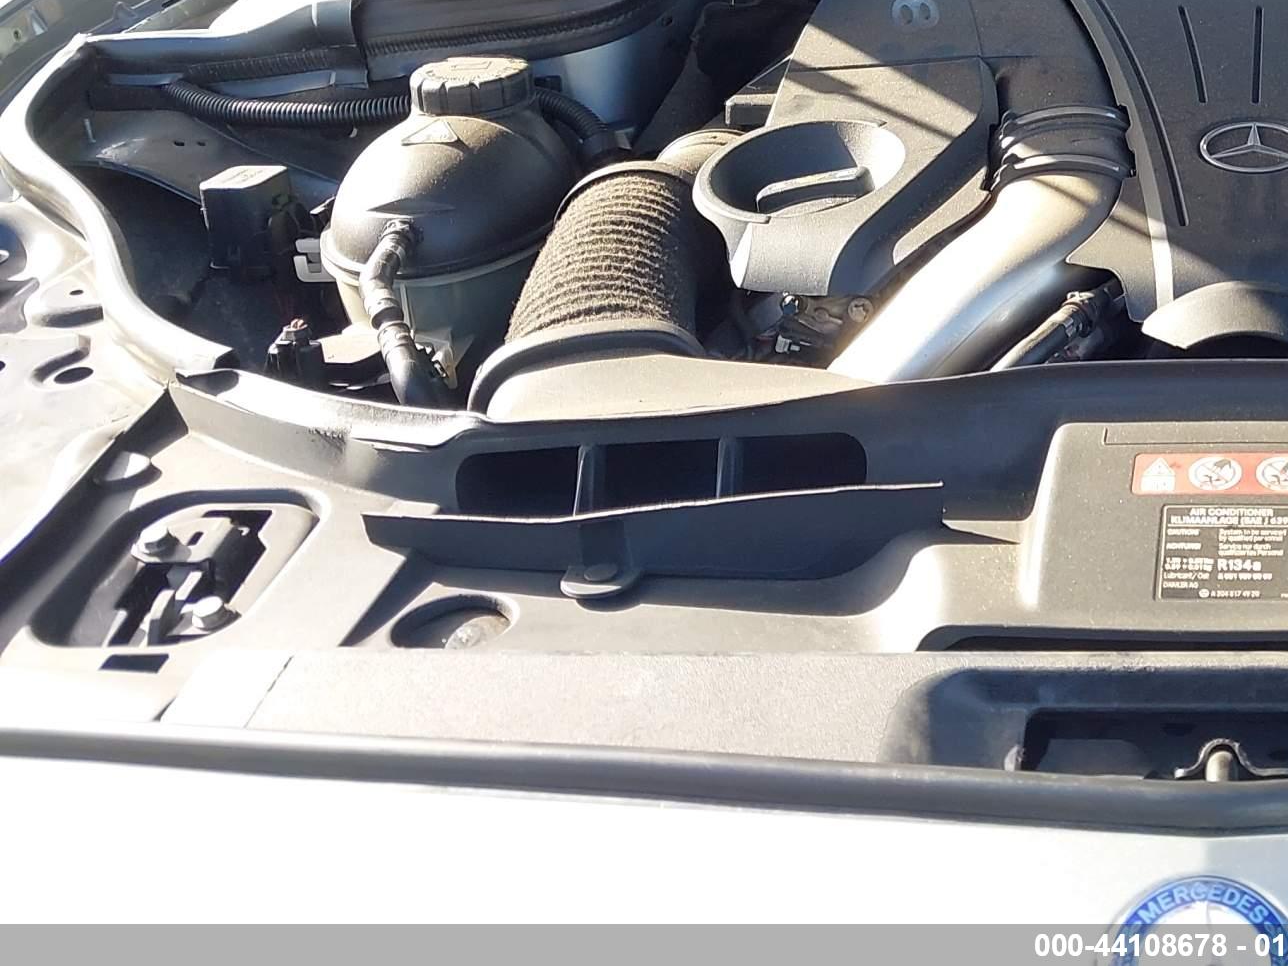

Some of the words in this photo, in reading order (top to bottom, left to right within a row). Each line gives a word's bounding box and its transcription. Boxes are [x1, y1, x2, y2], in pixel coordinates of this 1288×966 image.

[1190, 508, 1206, 517] AIR
[1208, 508, 1274, 517] CONDITIONER
[1217, 558, 1262, 571] R134a
[1137, 882, 1270, 924] MERCEDES
